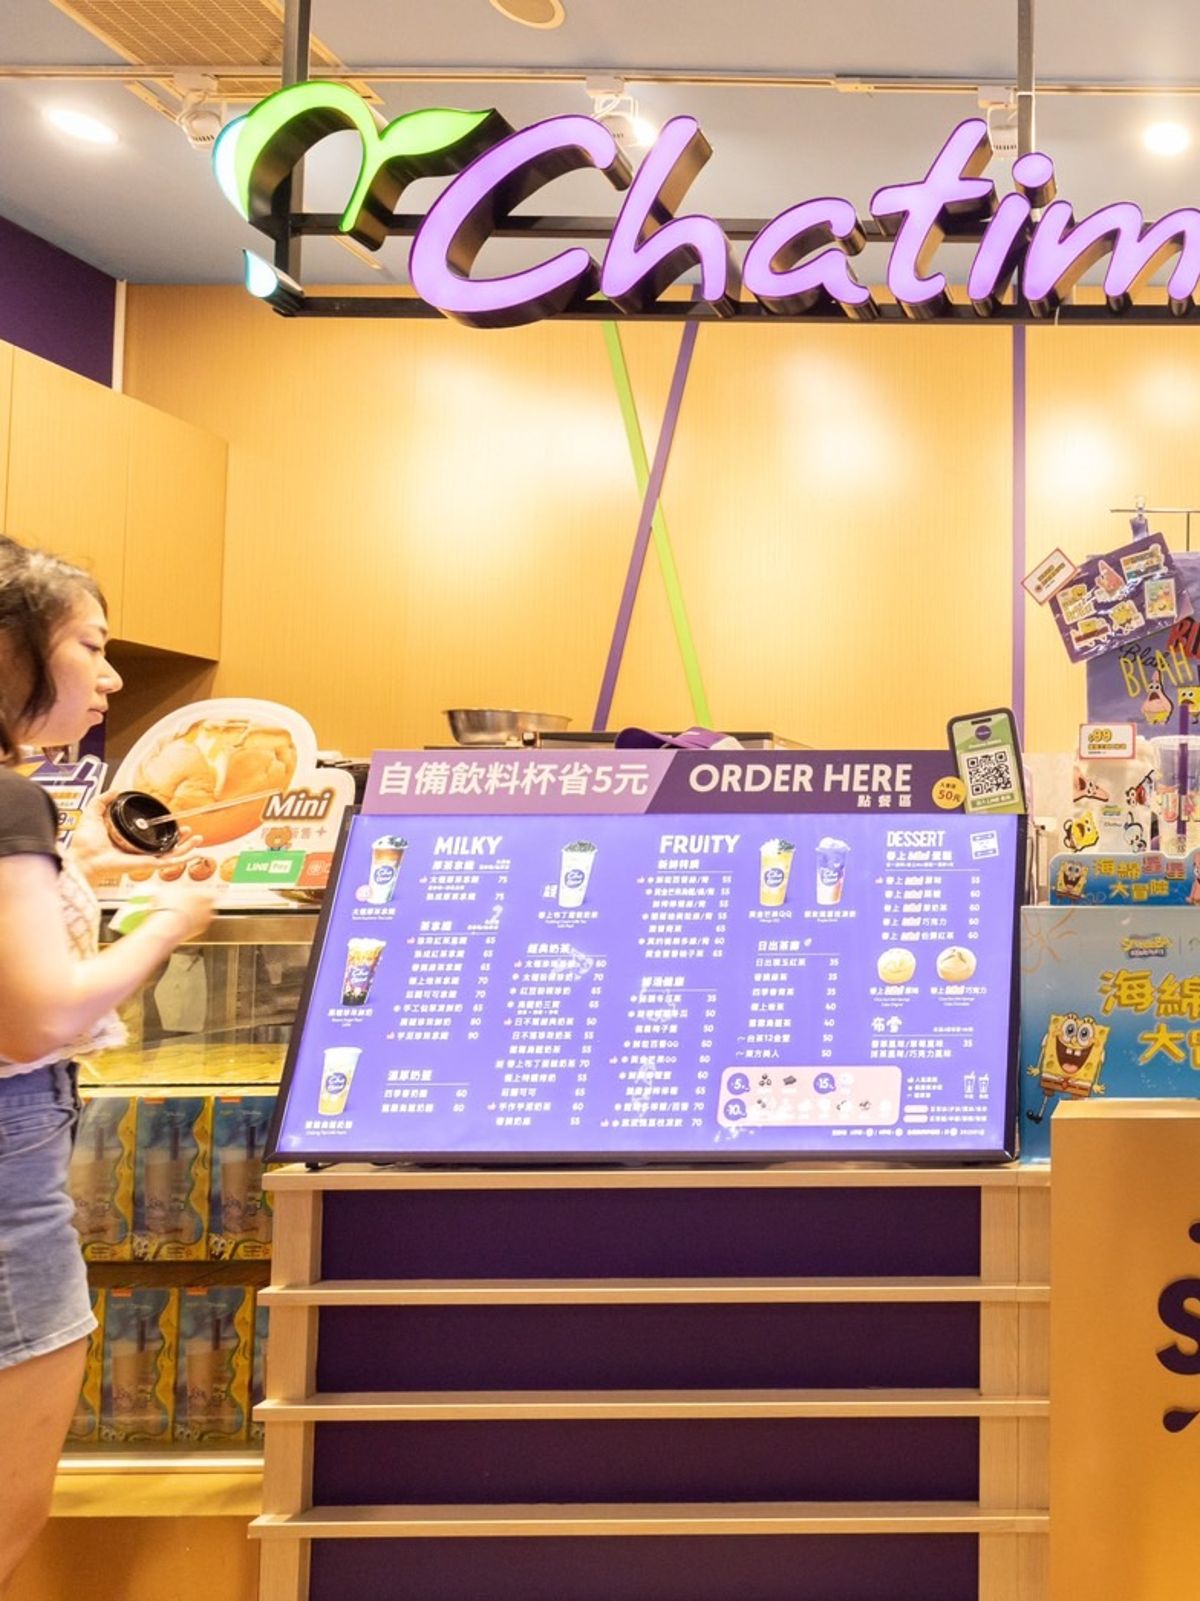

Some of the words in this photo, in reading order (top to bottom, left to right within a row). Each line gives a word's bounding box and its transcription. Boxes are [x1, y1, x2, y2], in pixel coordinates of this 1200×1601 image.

[1119, 642, 1194, 699] BLAH
[1088, 729, 1113, 742] $99
[379, 761, 650, 796] 自備飲料杯省5元
[689, 763, 814, 793] ORDER
[823, 763, 913, 793] HERE
[262, 787, 334, 820] Mini
[857, 794, 912, 808] 點餐區
[886, 830, 946, 848] DESSERT
[433, 835, 504, 856] MILKY
[659, 835, 741, 854] FRUITY
[1094, 854, 1187, 881] 海綿星星
[497, 876, 509, 884] 75
[1109, 879, 1170, 901] 大冒險
[494, 893, 505, 901] 75
[485, 937, 496, 945] 65
[483, 950, 493, 958] 65
[829, 958, 839, 967] 35
[477, 976, 489, 985] 70
[593, 974, 605, 982] 70
[475, 990, 486, 999] 70
[826, 988, 836, 996] 35
[472, 1004, 483, 1013] 65
[579, 1059, 591, 1068] 70
[693, 1102, 705, 1111] 70
[691, 1118, 703, 1127] 70
